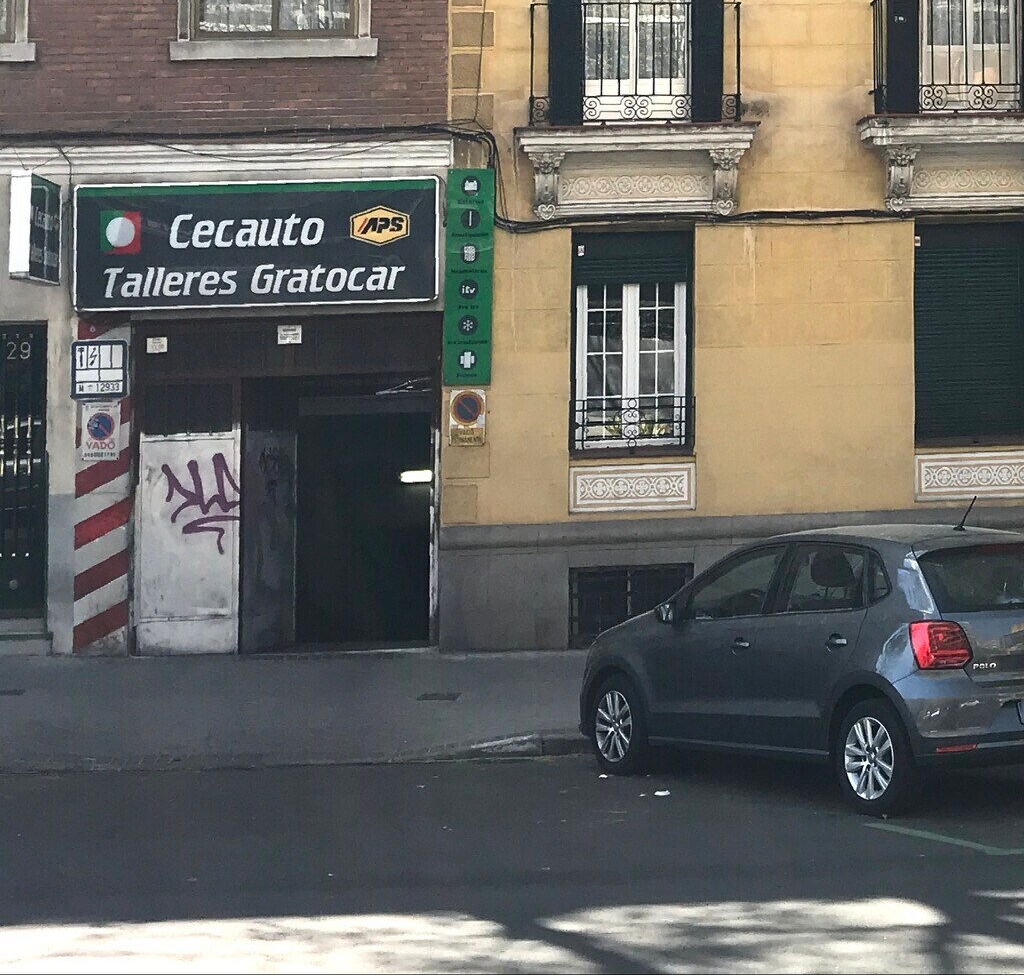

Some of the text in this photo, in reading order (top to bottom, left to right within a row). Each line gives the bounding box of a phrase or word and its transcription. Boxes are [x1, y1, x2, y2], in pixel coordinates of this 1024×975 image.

[169, 213, 325, 249] Cecauto
[358, 216, 406, 234] APS
[103, 264, 406, 299] Talleres Gratocar
[6, 341, 31, 360] 29
[85, 441, 116, 450] VADO
